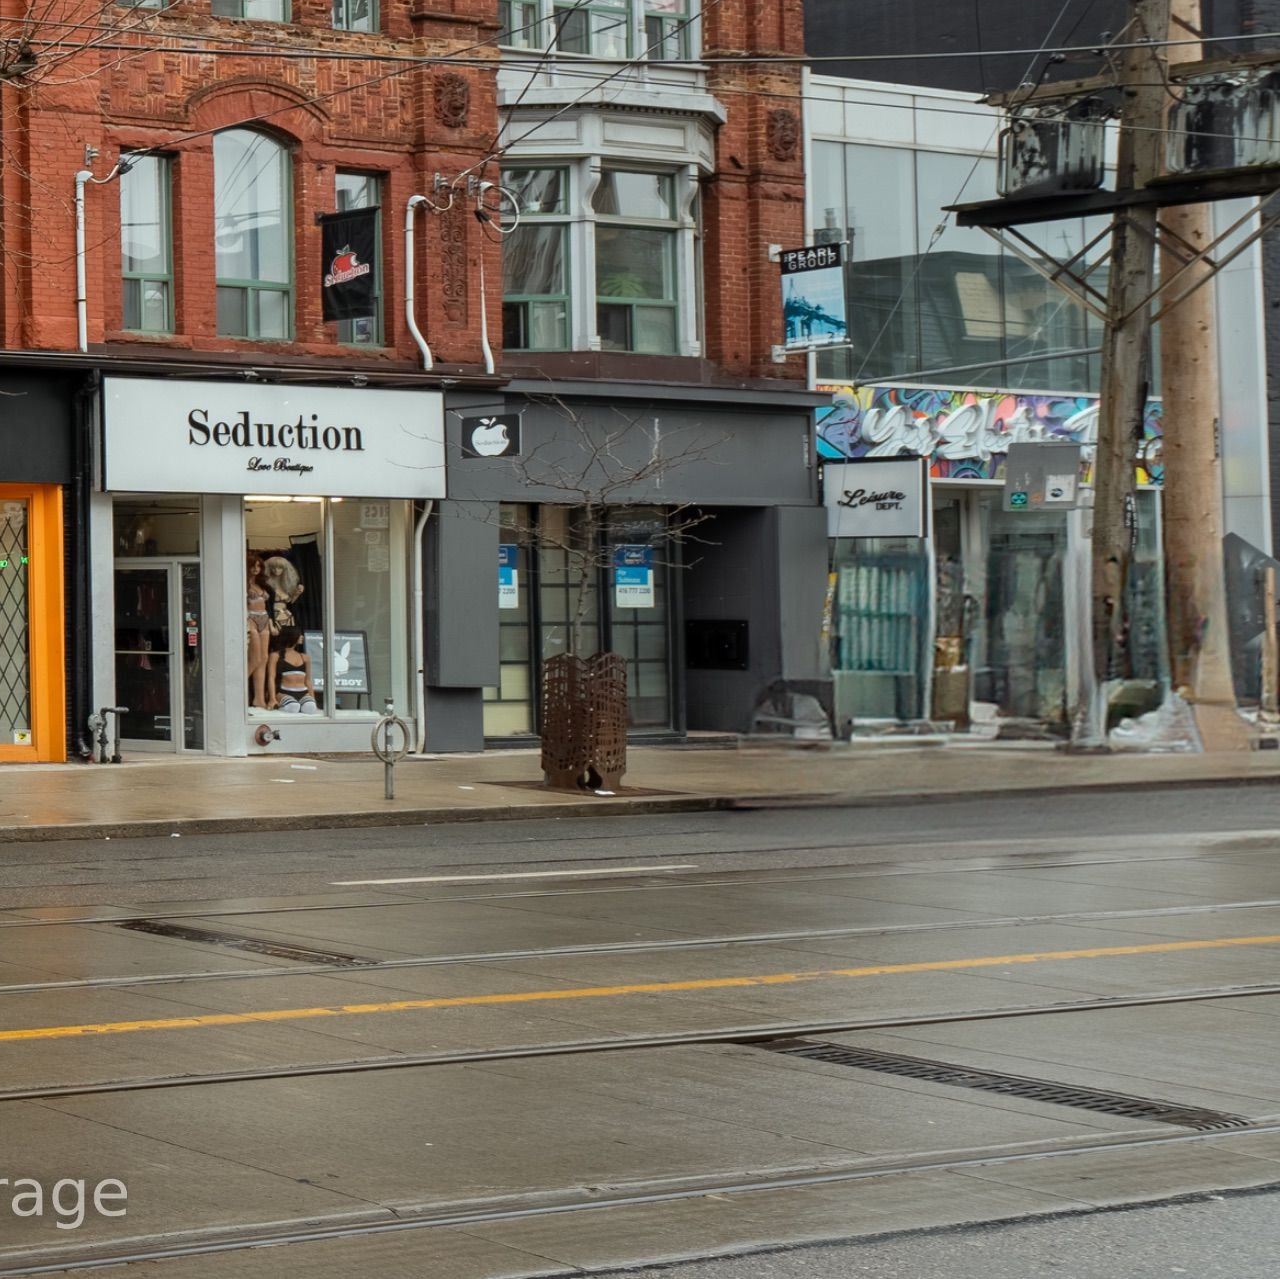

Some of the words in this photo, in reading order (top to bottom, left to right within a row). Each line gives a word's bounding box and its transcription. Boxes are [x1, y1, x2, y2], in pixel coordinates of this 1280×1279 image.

[788, 247, 836, 261] PEARL
[788, 255, 837, 270] GROUP
[188, 408, 365, 451] Seduction
[246, 456, 272, 471] Love
[273, 458, 314, 476] Boutique
[837, 488, 906, 508] Leisure
[875, 502, 902, 511] DEPT.
[313, 678, 363, 686] PLYBOY
